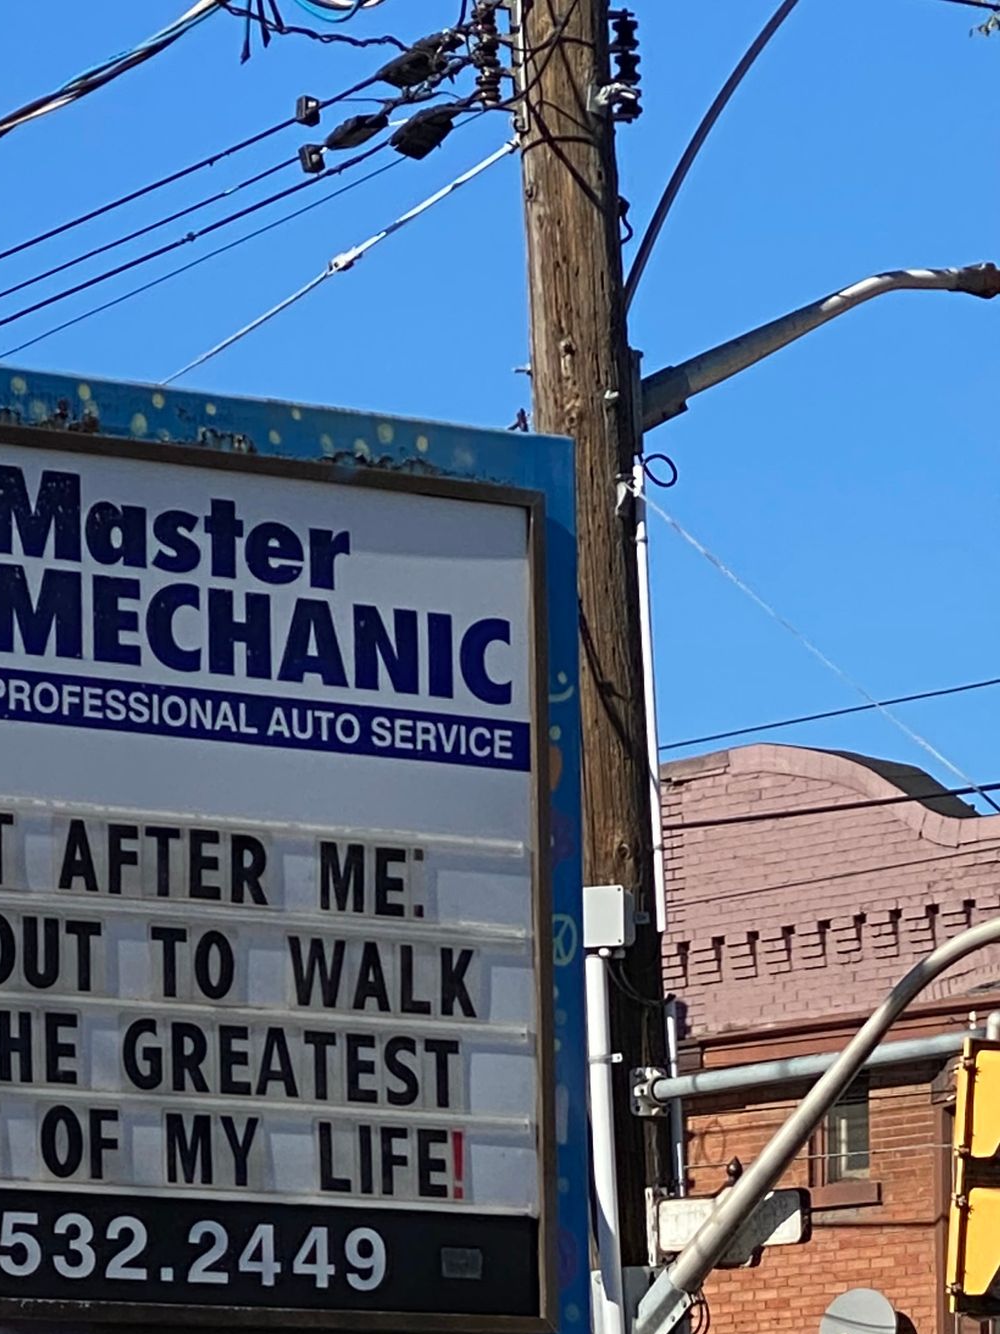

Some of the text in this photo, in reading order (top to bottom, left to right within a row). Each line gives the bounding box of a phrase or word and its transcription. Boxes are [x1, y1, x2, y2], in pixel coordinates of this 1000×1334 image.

[267, 706, 361, 746] AUTO
[371, 716, 514, 760] SERVICE
[58, 818, 269, 906] AFTER
[319, 840, 425, 918] ME:
[150, 926, 236, 1000] TO
[287, 935, 478, 1019] WALK
[122, 1017, 460, 1109] GREATEST
[40, 1104, 120, 1180] OF
[165, 1112, 260, 1187] MY
[318, 1121, 465, 1200] LIFE!
